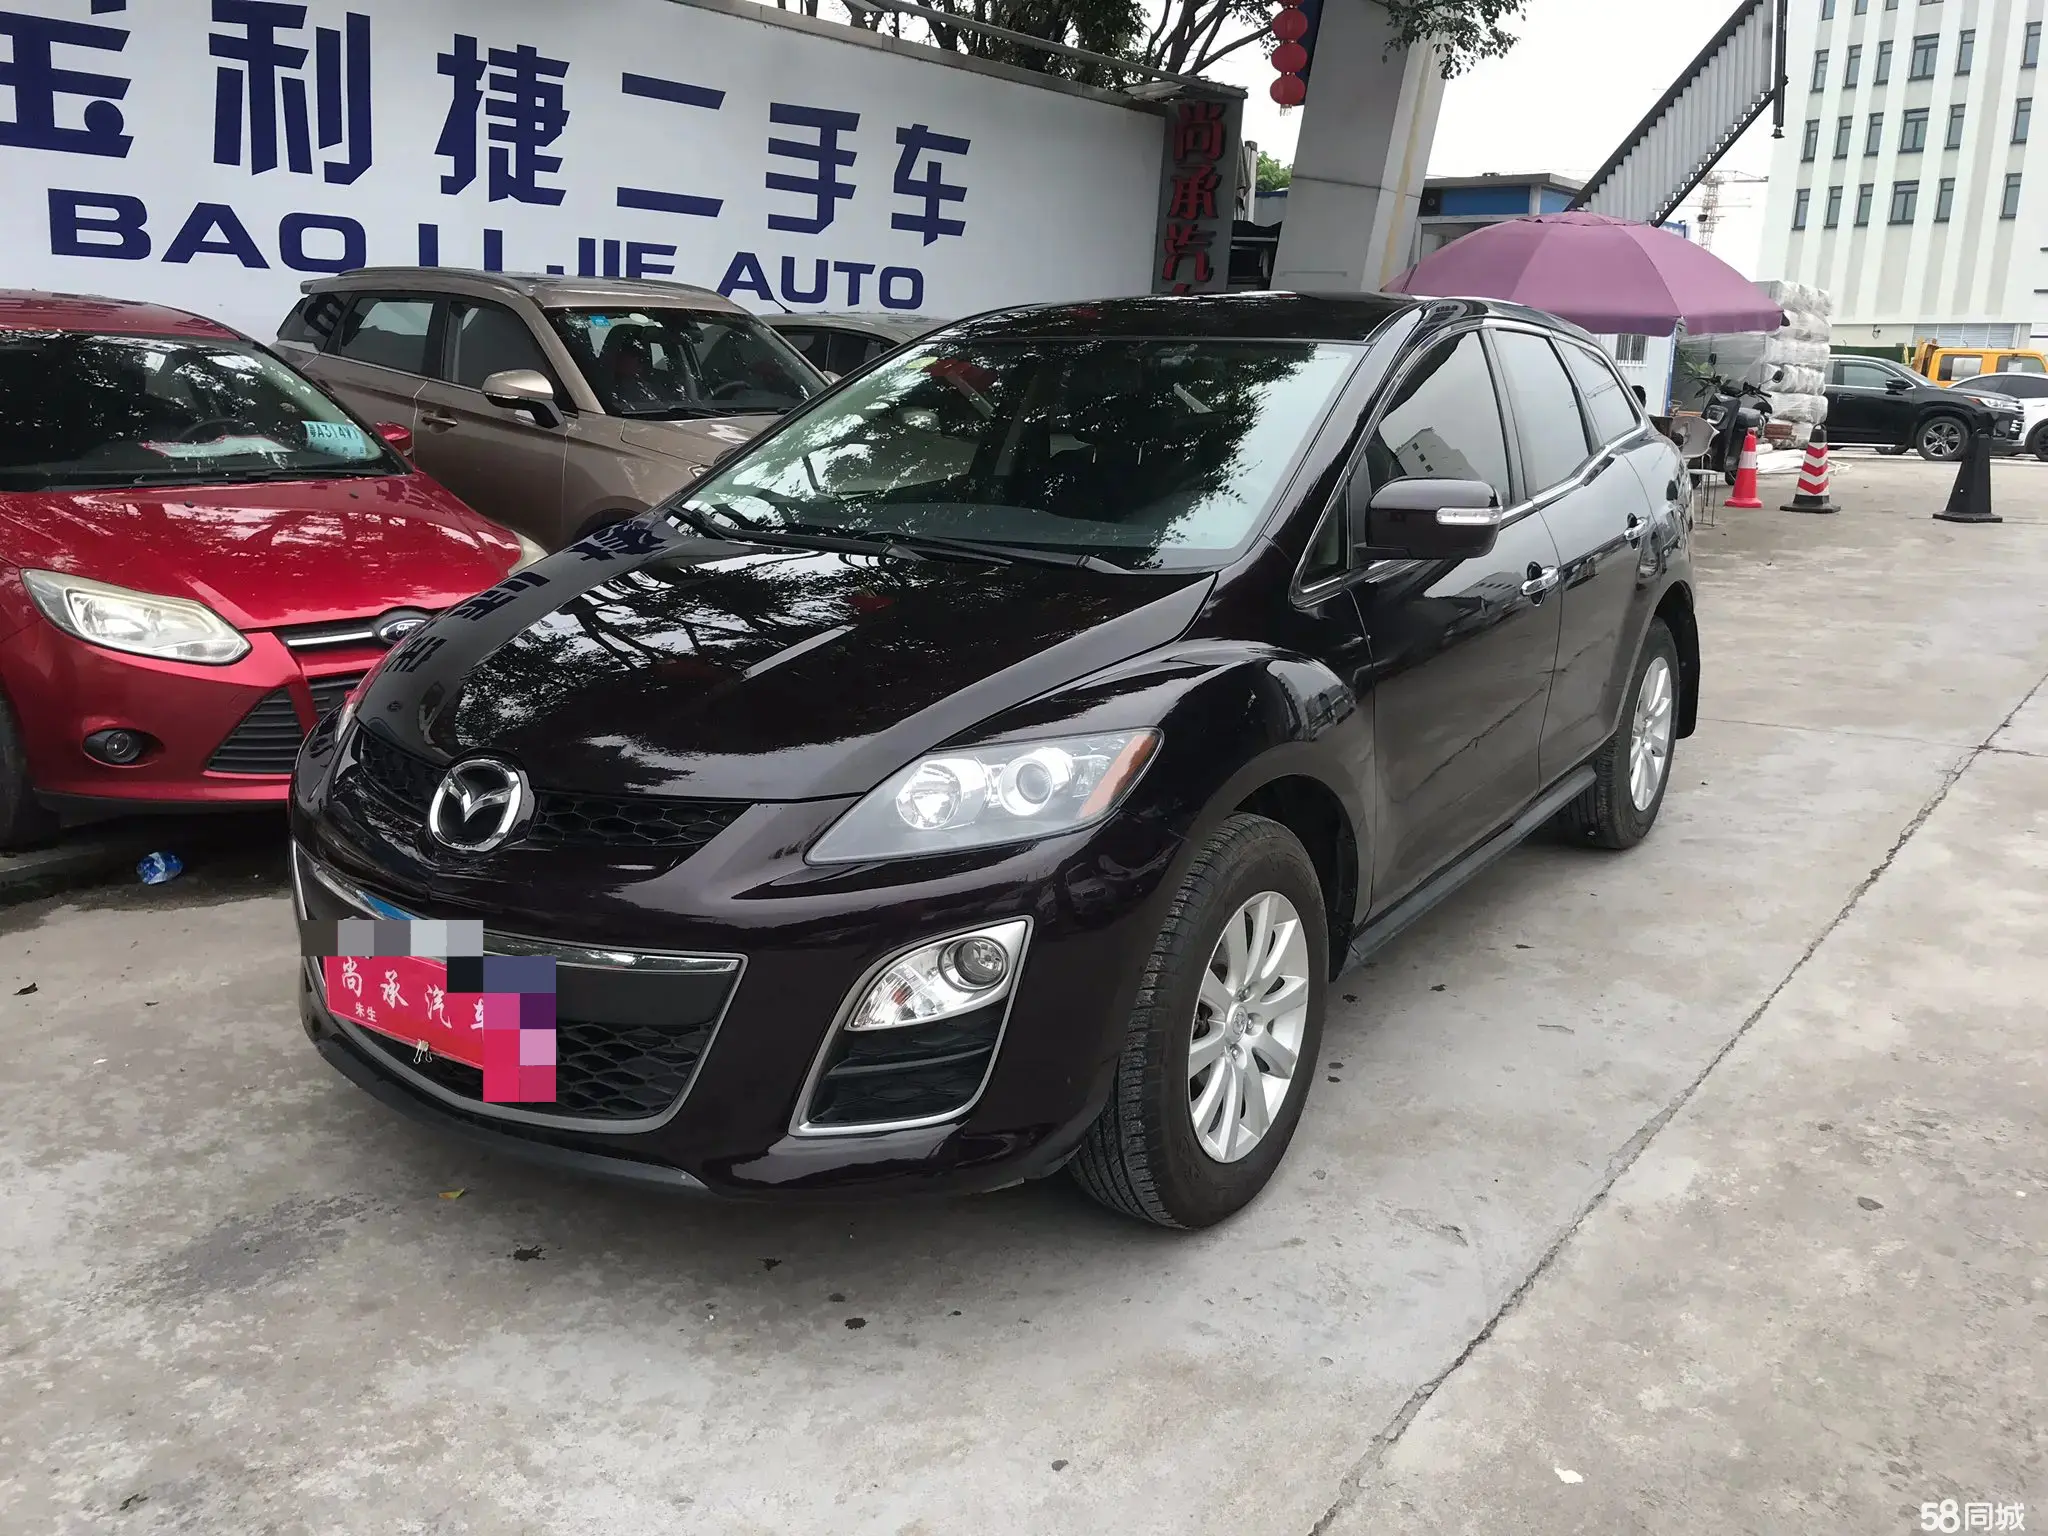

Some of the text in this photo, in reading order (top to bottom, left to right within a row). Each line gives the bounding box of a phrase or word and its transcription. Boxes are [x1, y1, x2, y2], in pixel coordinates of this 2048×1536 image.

[48, 188, 367, 275] BAO
[716, 252, 924, 311] AUTO
[1162, 101, 1226, 296] 尚承汽
